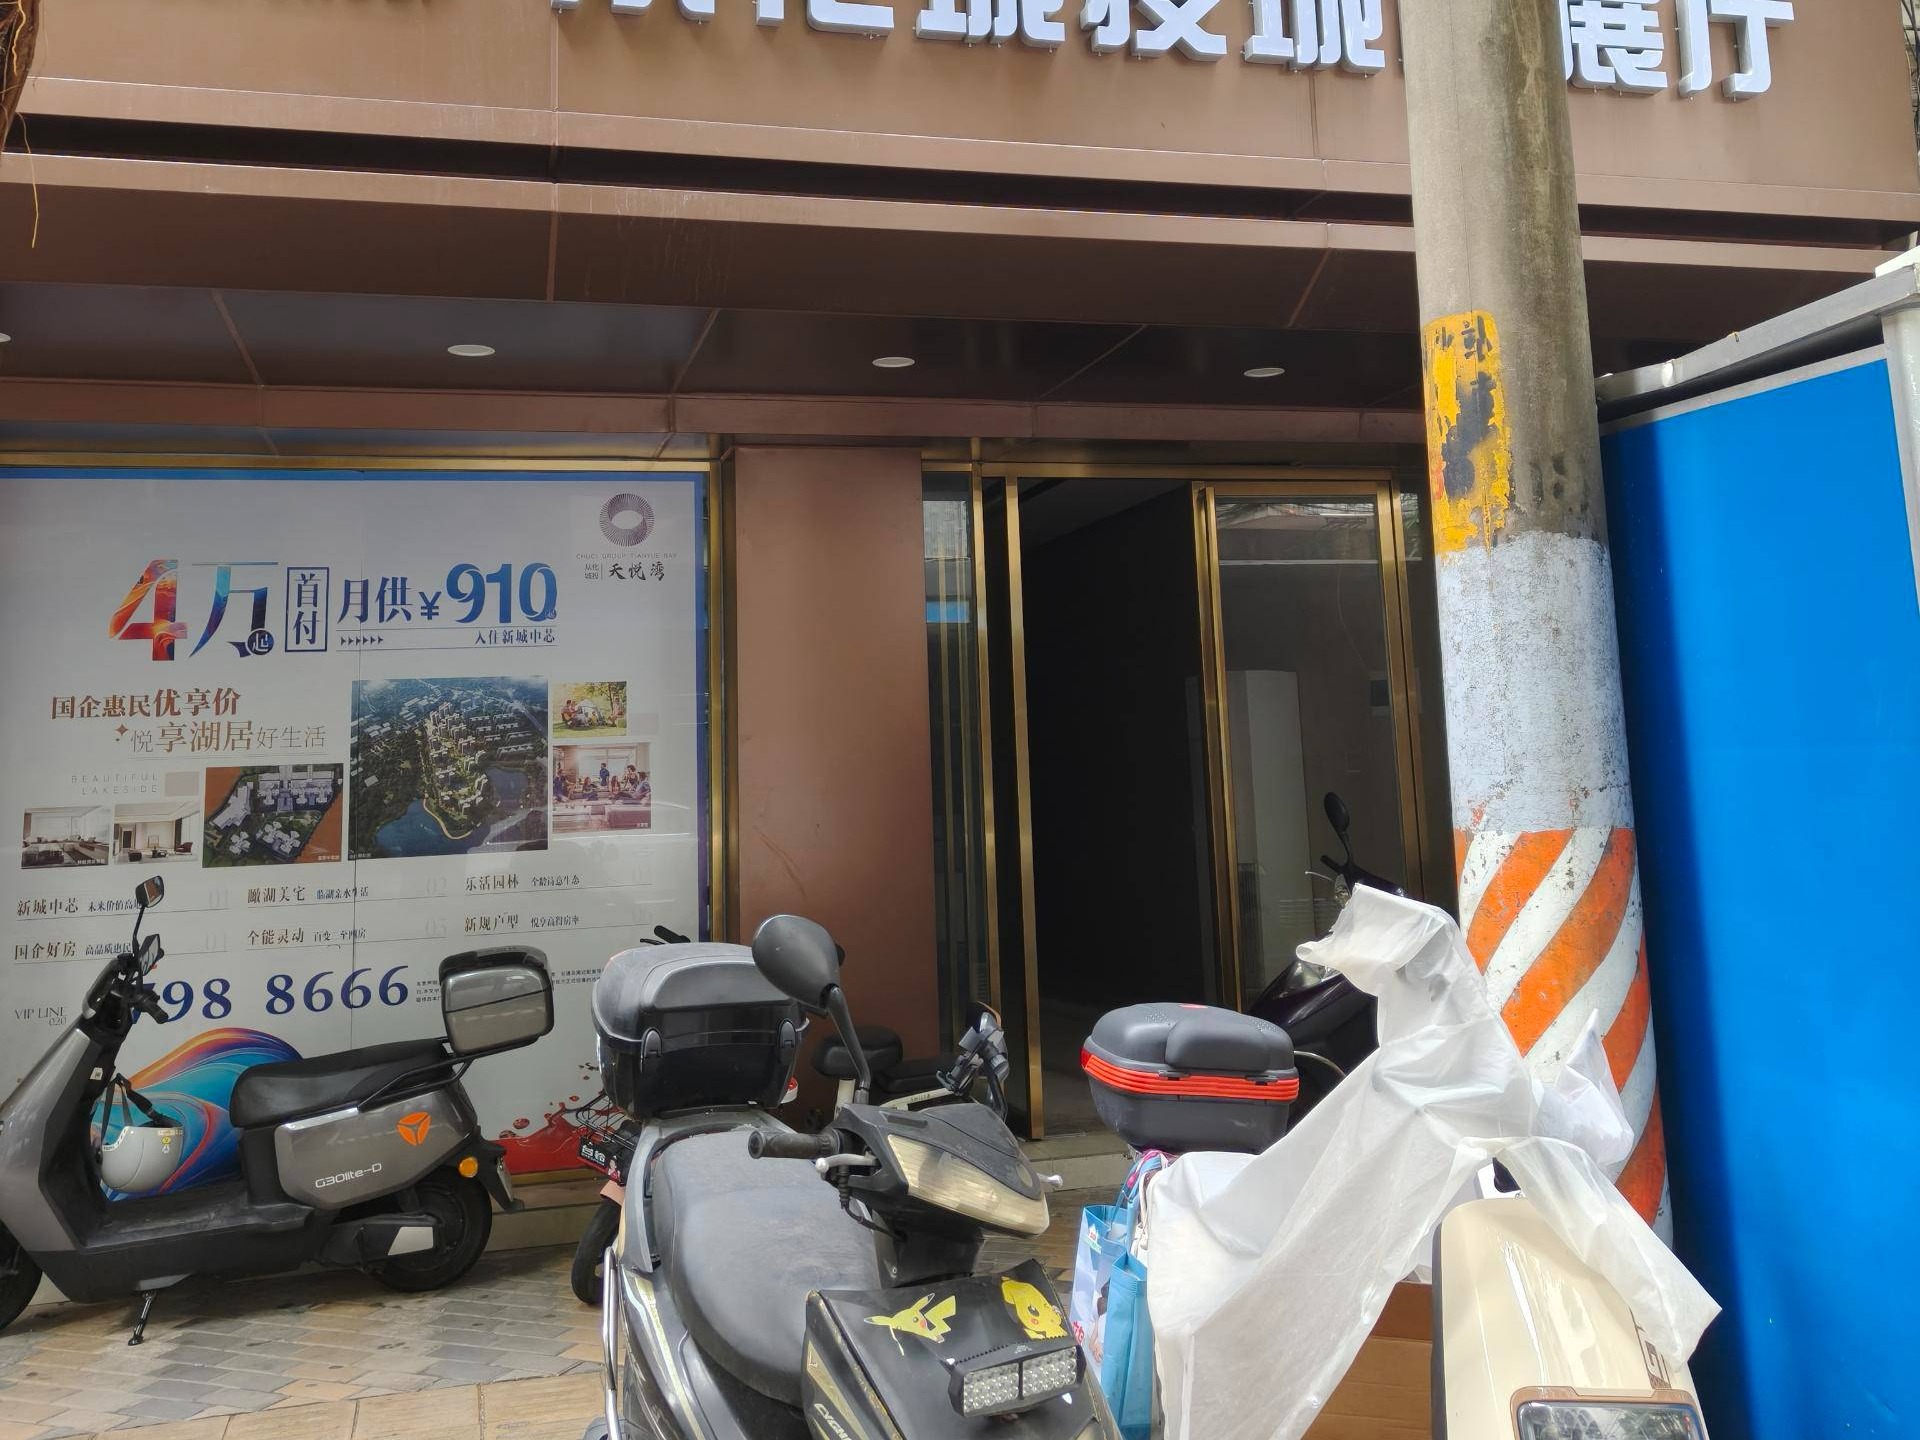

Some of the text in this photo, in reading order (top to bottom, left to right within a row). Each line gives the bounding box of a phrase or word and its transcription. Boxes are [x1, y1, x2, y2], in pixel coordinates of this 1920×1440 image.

[294, 573, 321, 645] 首付
[474, 630, 556, 646] 入住新城中芯
[51, 687, 241, 720] 国企惠民优享价
[131, 720, 326, 754] 悦享湖居好生活
[465, 873, 519, 891] 乐活园林
[16, 897, 79, 916] 新城中芯
[464, 913, 519, 932] 新规户型
[14, 941, 77, 960] 国企好房
[265, 965, 409, 1015] 8666
